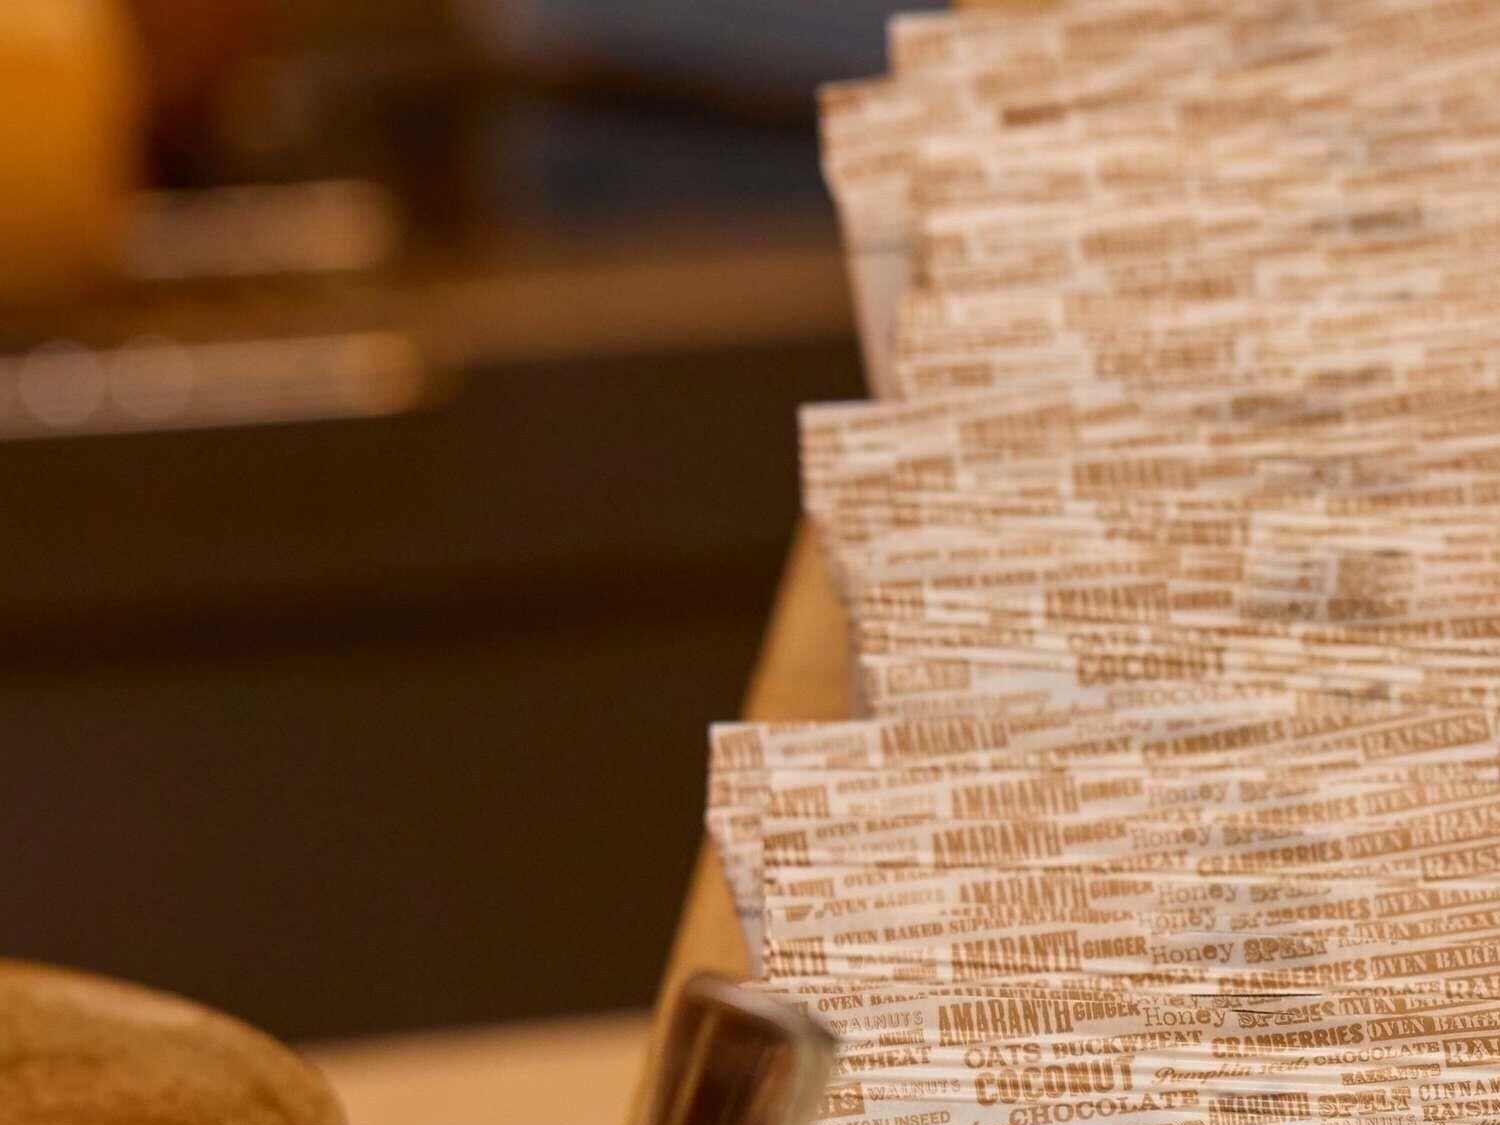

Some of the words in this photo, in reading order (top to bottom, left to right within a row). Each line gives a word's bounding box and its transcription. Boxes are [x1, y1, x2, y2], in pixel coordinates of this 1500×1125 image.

[833, 931, 879, 946] OVEN
[1083, 935, 1148, 960] GINGER
[1151, 942, 1235, 965] Honey
[938, 999, 1075, 1047] AMARANTH
[1072, 1000, 1141, 1021] GINGER
[1143, 1006, 1227, 1028] Honey
[1050, 1030, 1203, 1060] BUCKWHEAT
[1211, 1022, 1365, 1058] CRANBERRIES
[964, 1042, 1042, 1069] OATS
[1313, 1041, 1440, 1067] CHOCOLATE
[974, 1053, 1137, 1107] COCONUT
